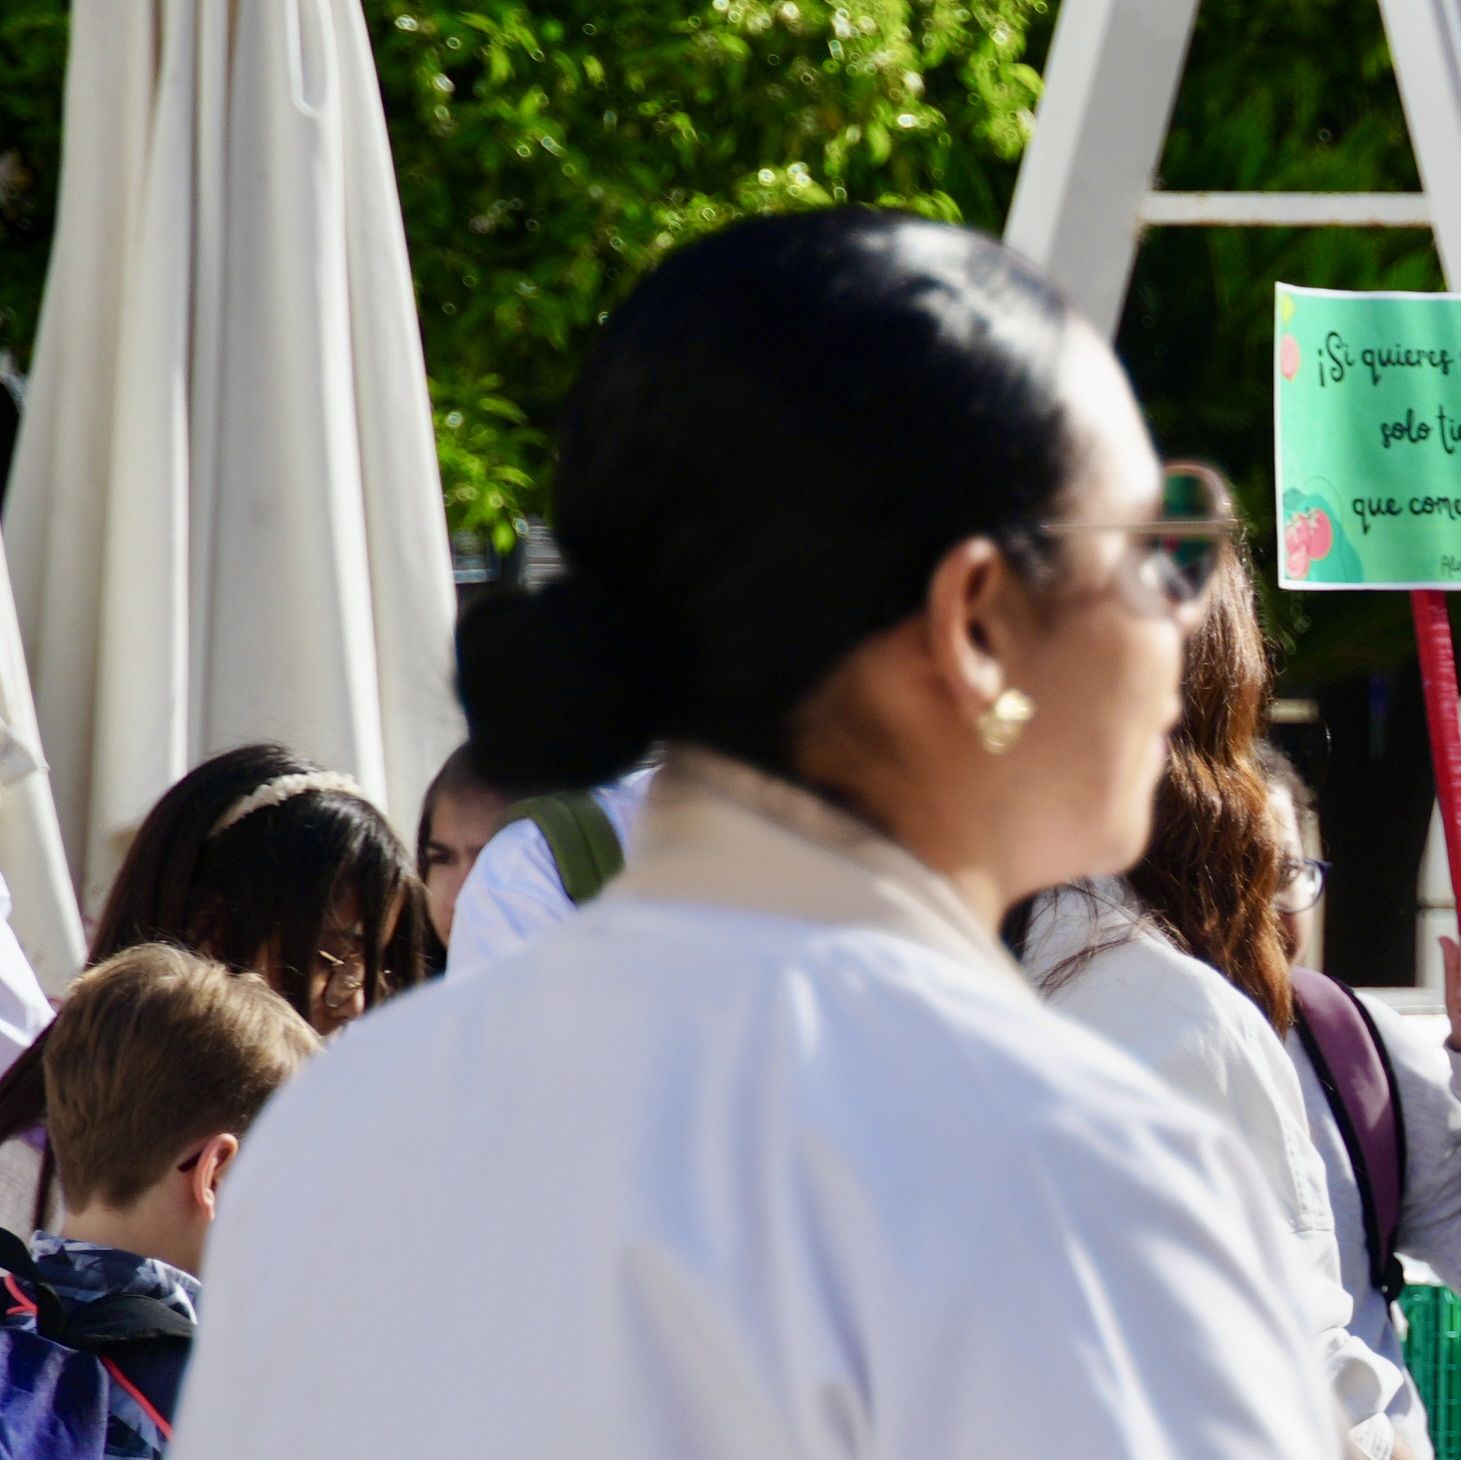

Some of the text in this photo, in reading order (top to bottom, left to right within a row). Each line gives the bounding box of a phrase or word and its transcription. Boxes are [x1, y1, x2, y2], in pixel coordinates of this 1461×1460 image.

[1361, 344, 1453, 386] quieres
[1379, 407, 1432, 449] solo
[1351, 497, 1402, 536] que
